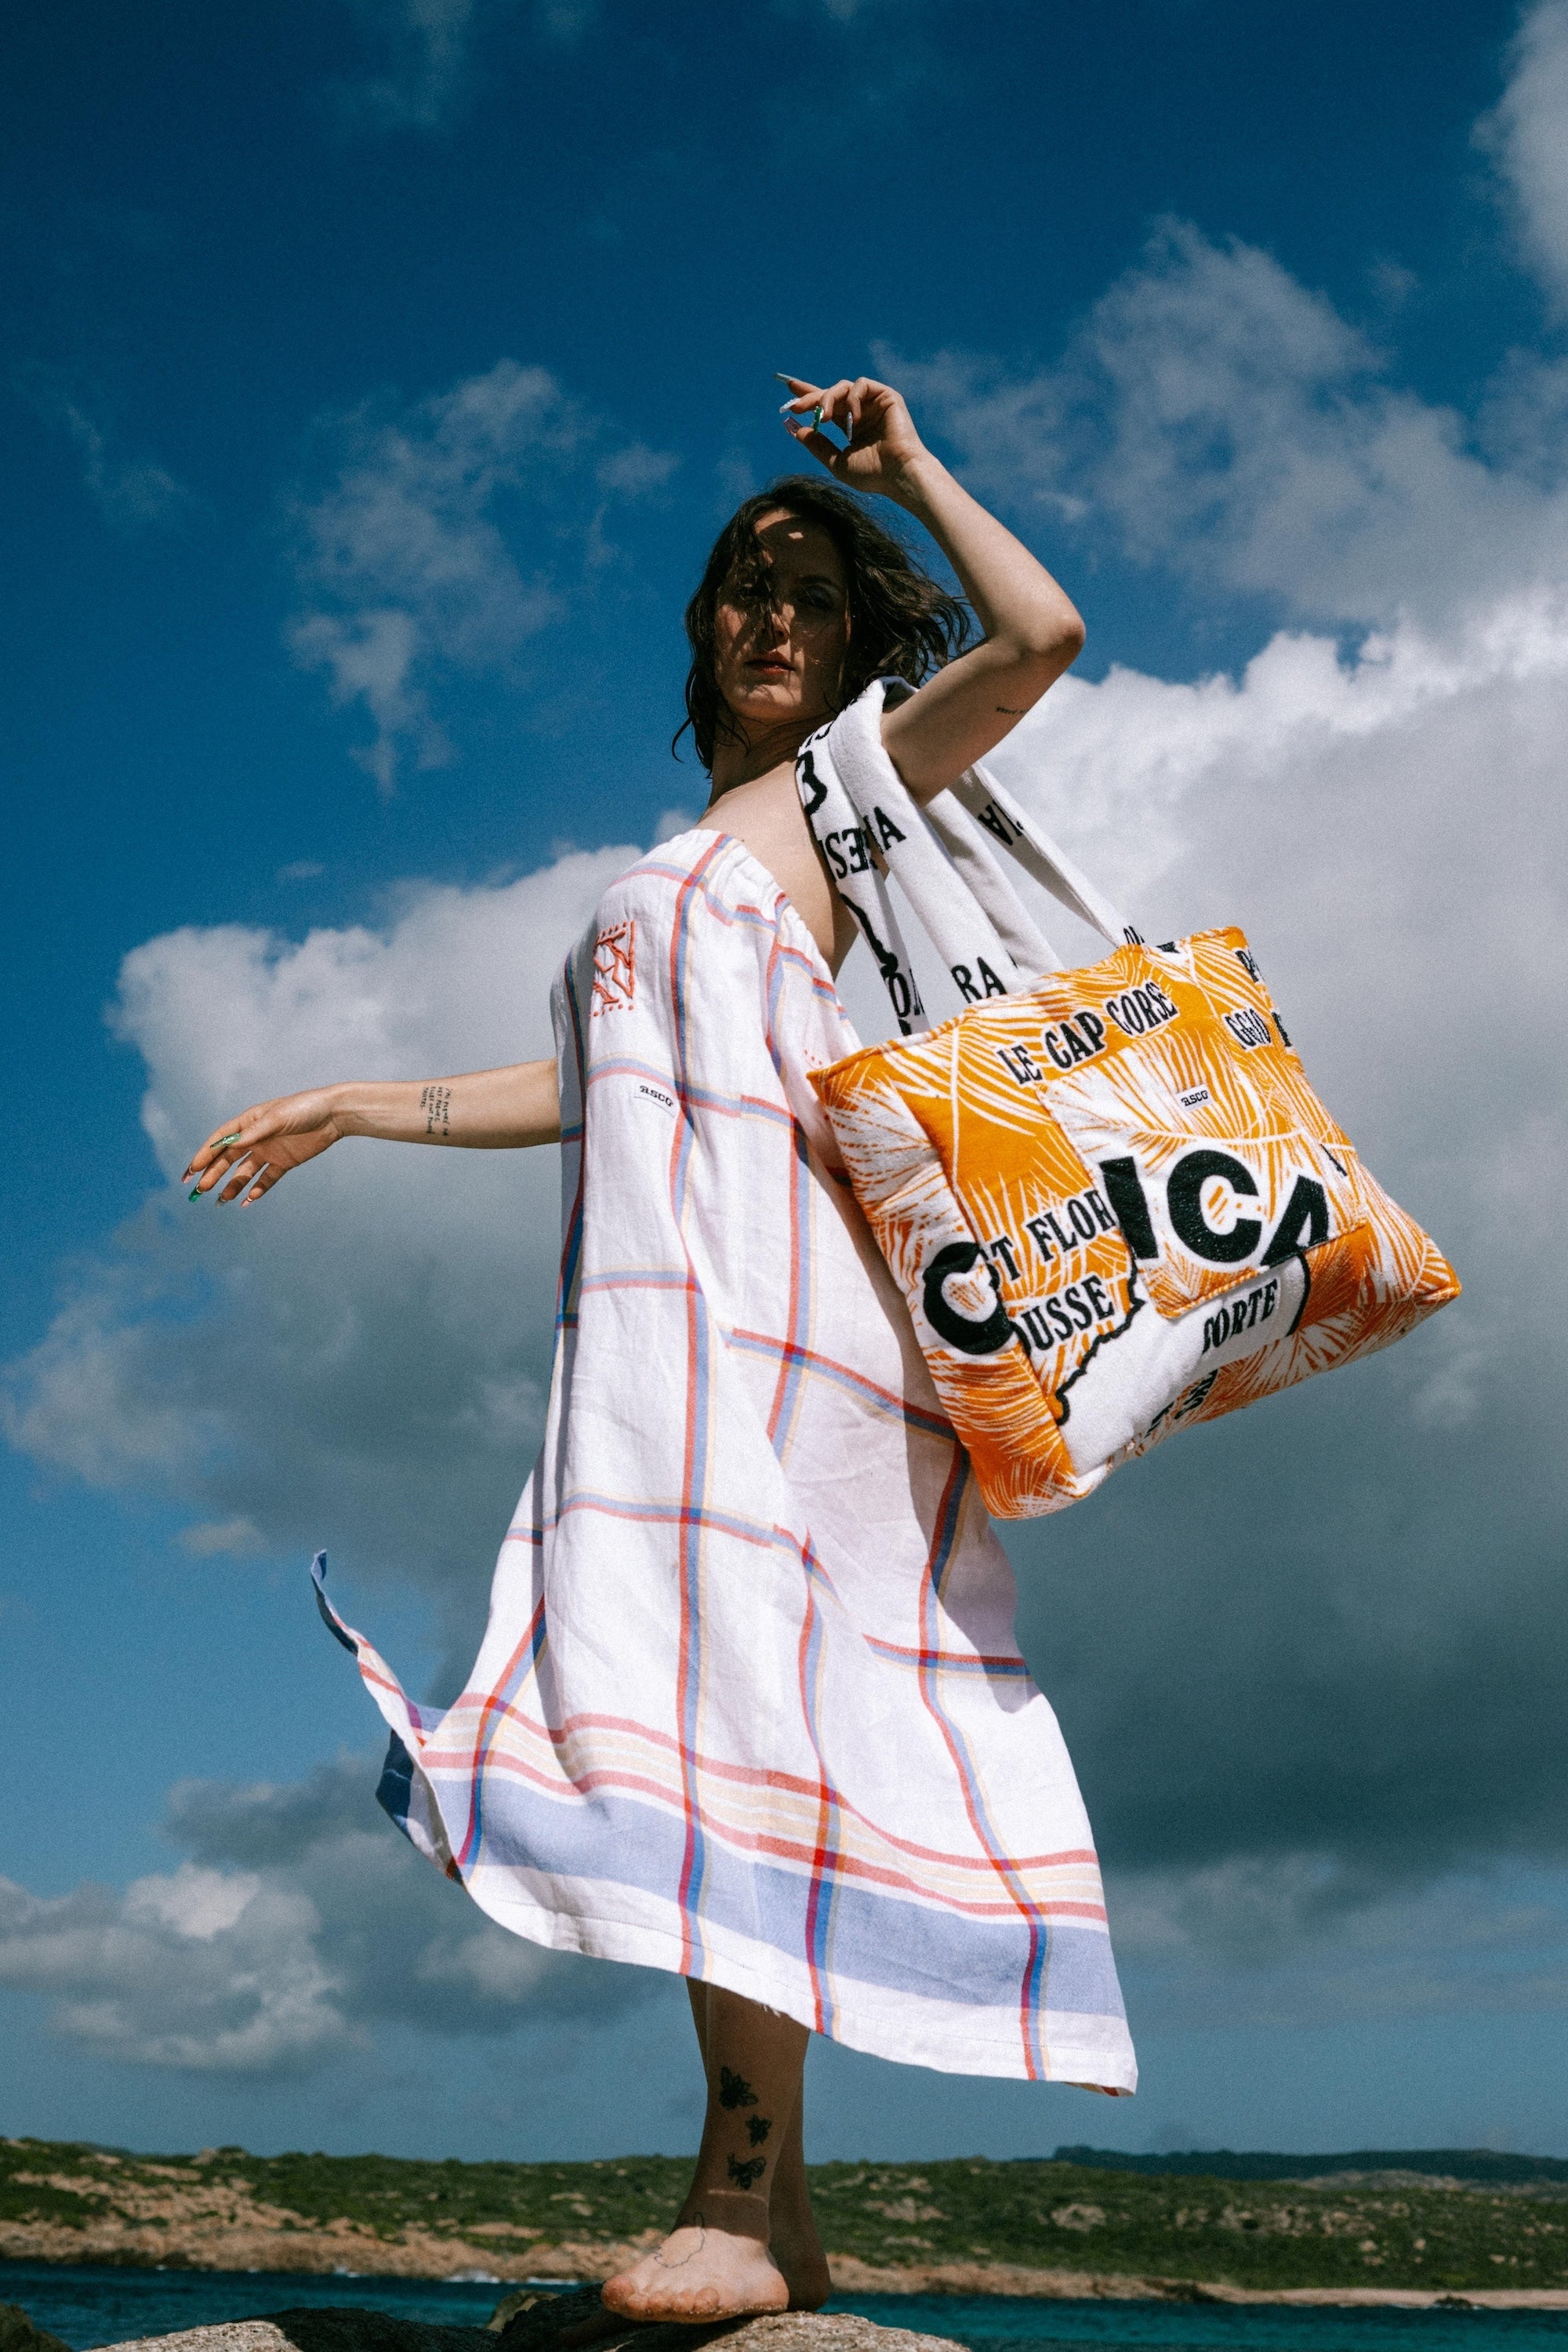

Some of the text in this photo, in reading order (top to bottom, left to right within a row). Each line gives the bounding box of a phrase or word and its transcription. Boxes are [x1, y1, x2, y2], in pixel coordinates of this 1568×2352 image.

[997, 981, 1179, 1085] LE CAP CORSE
[1099, 1149, 1331, 1269] ICA
